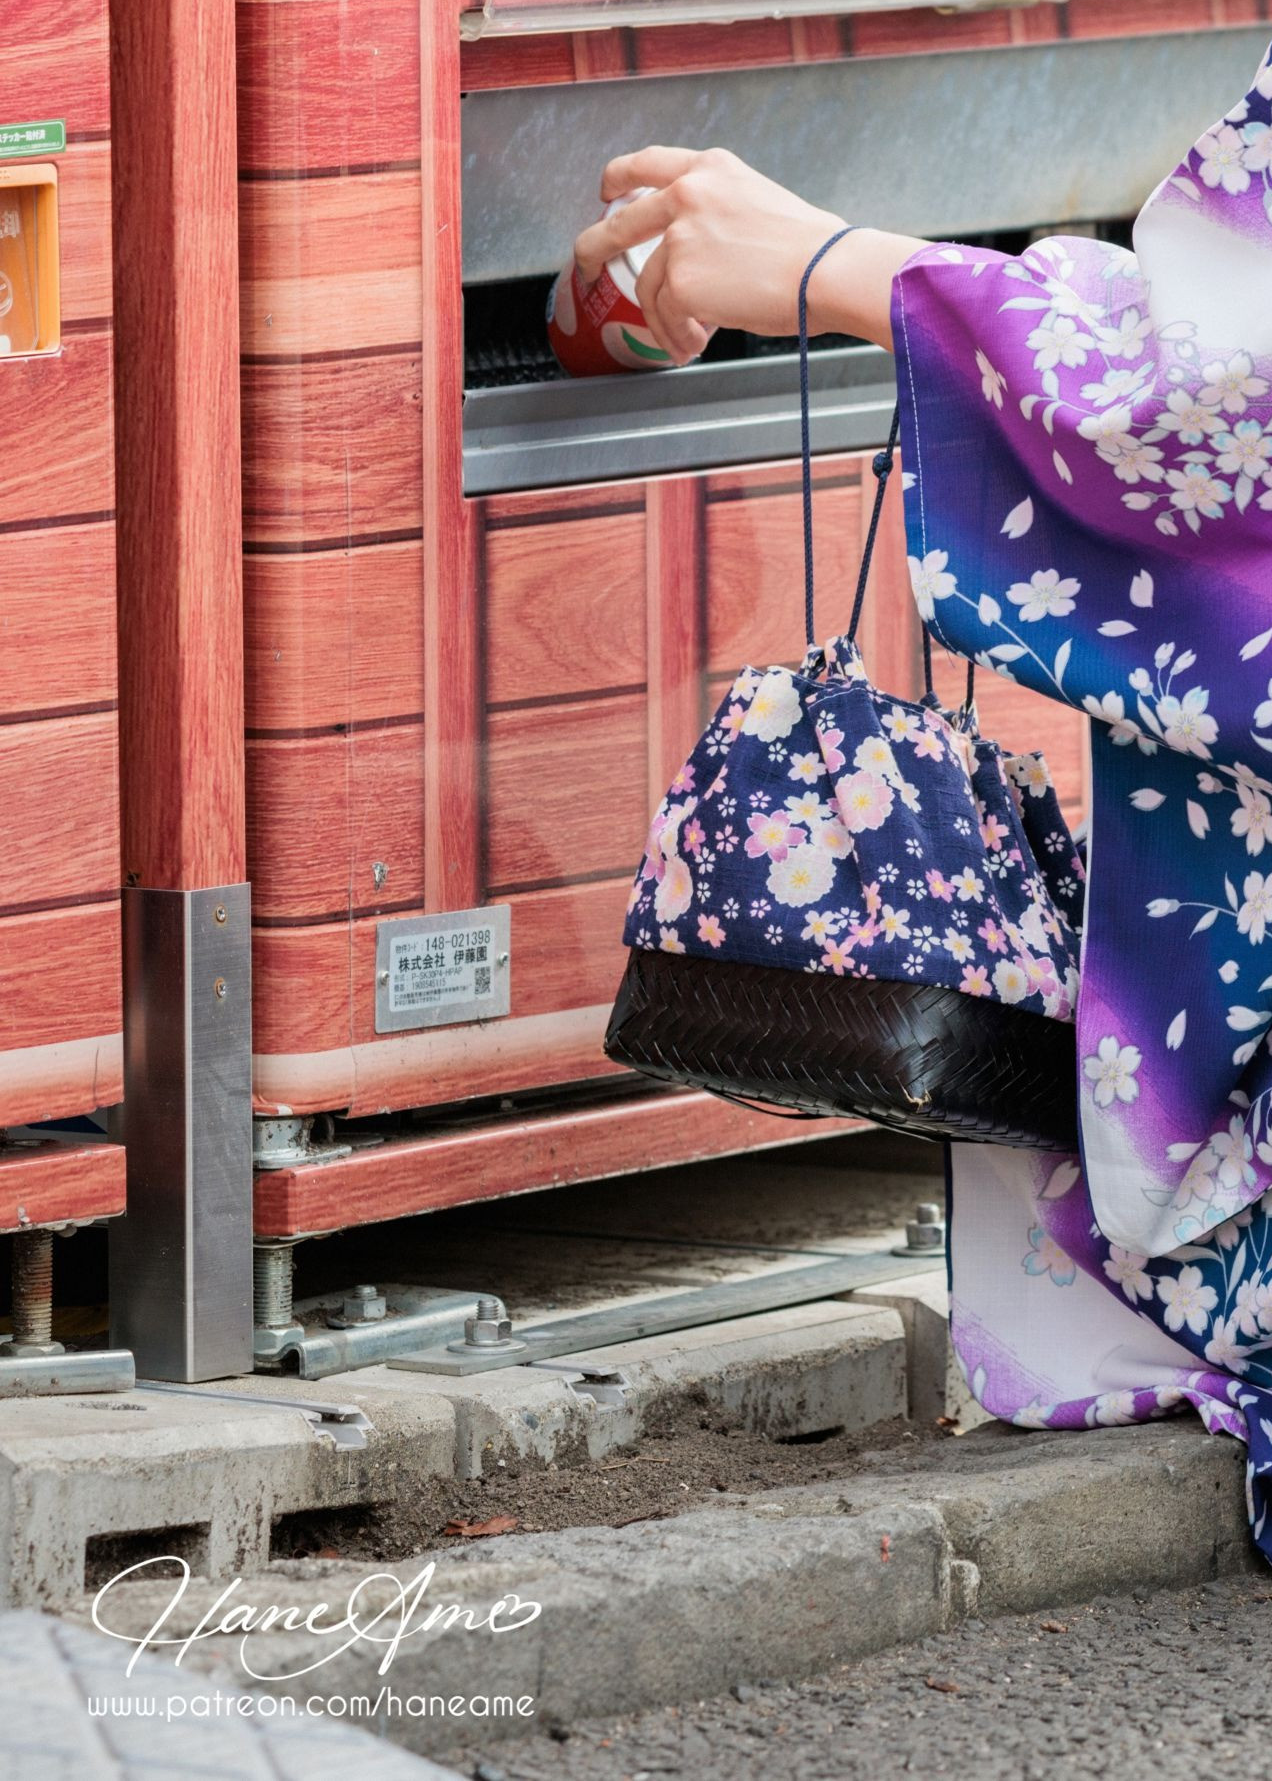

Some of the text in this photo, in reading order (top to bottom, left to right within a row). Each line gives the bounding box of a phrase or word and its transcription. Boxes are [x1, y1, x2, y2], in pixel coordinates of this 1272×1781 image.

[425, 929, 491, 952] 148-021398
[398, 945, 487, 973] 株式会社 伊藤園
